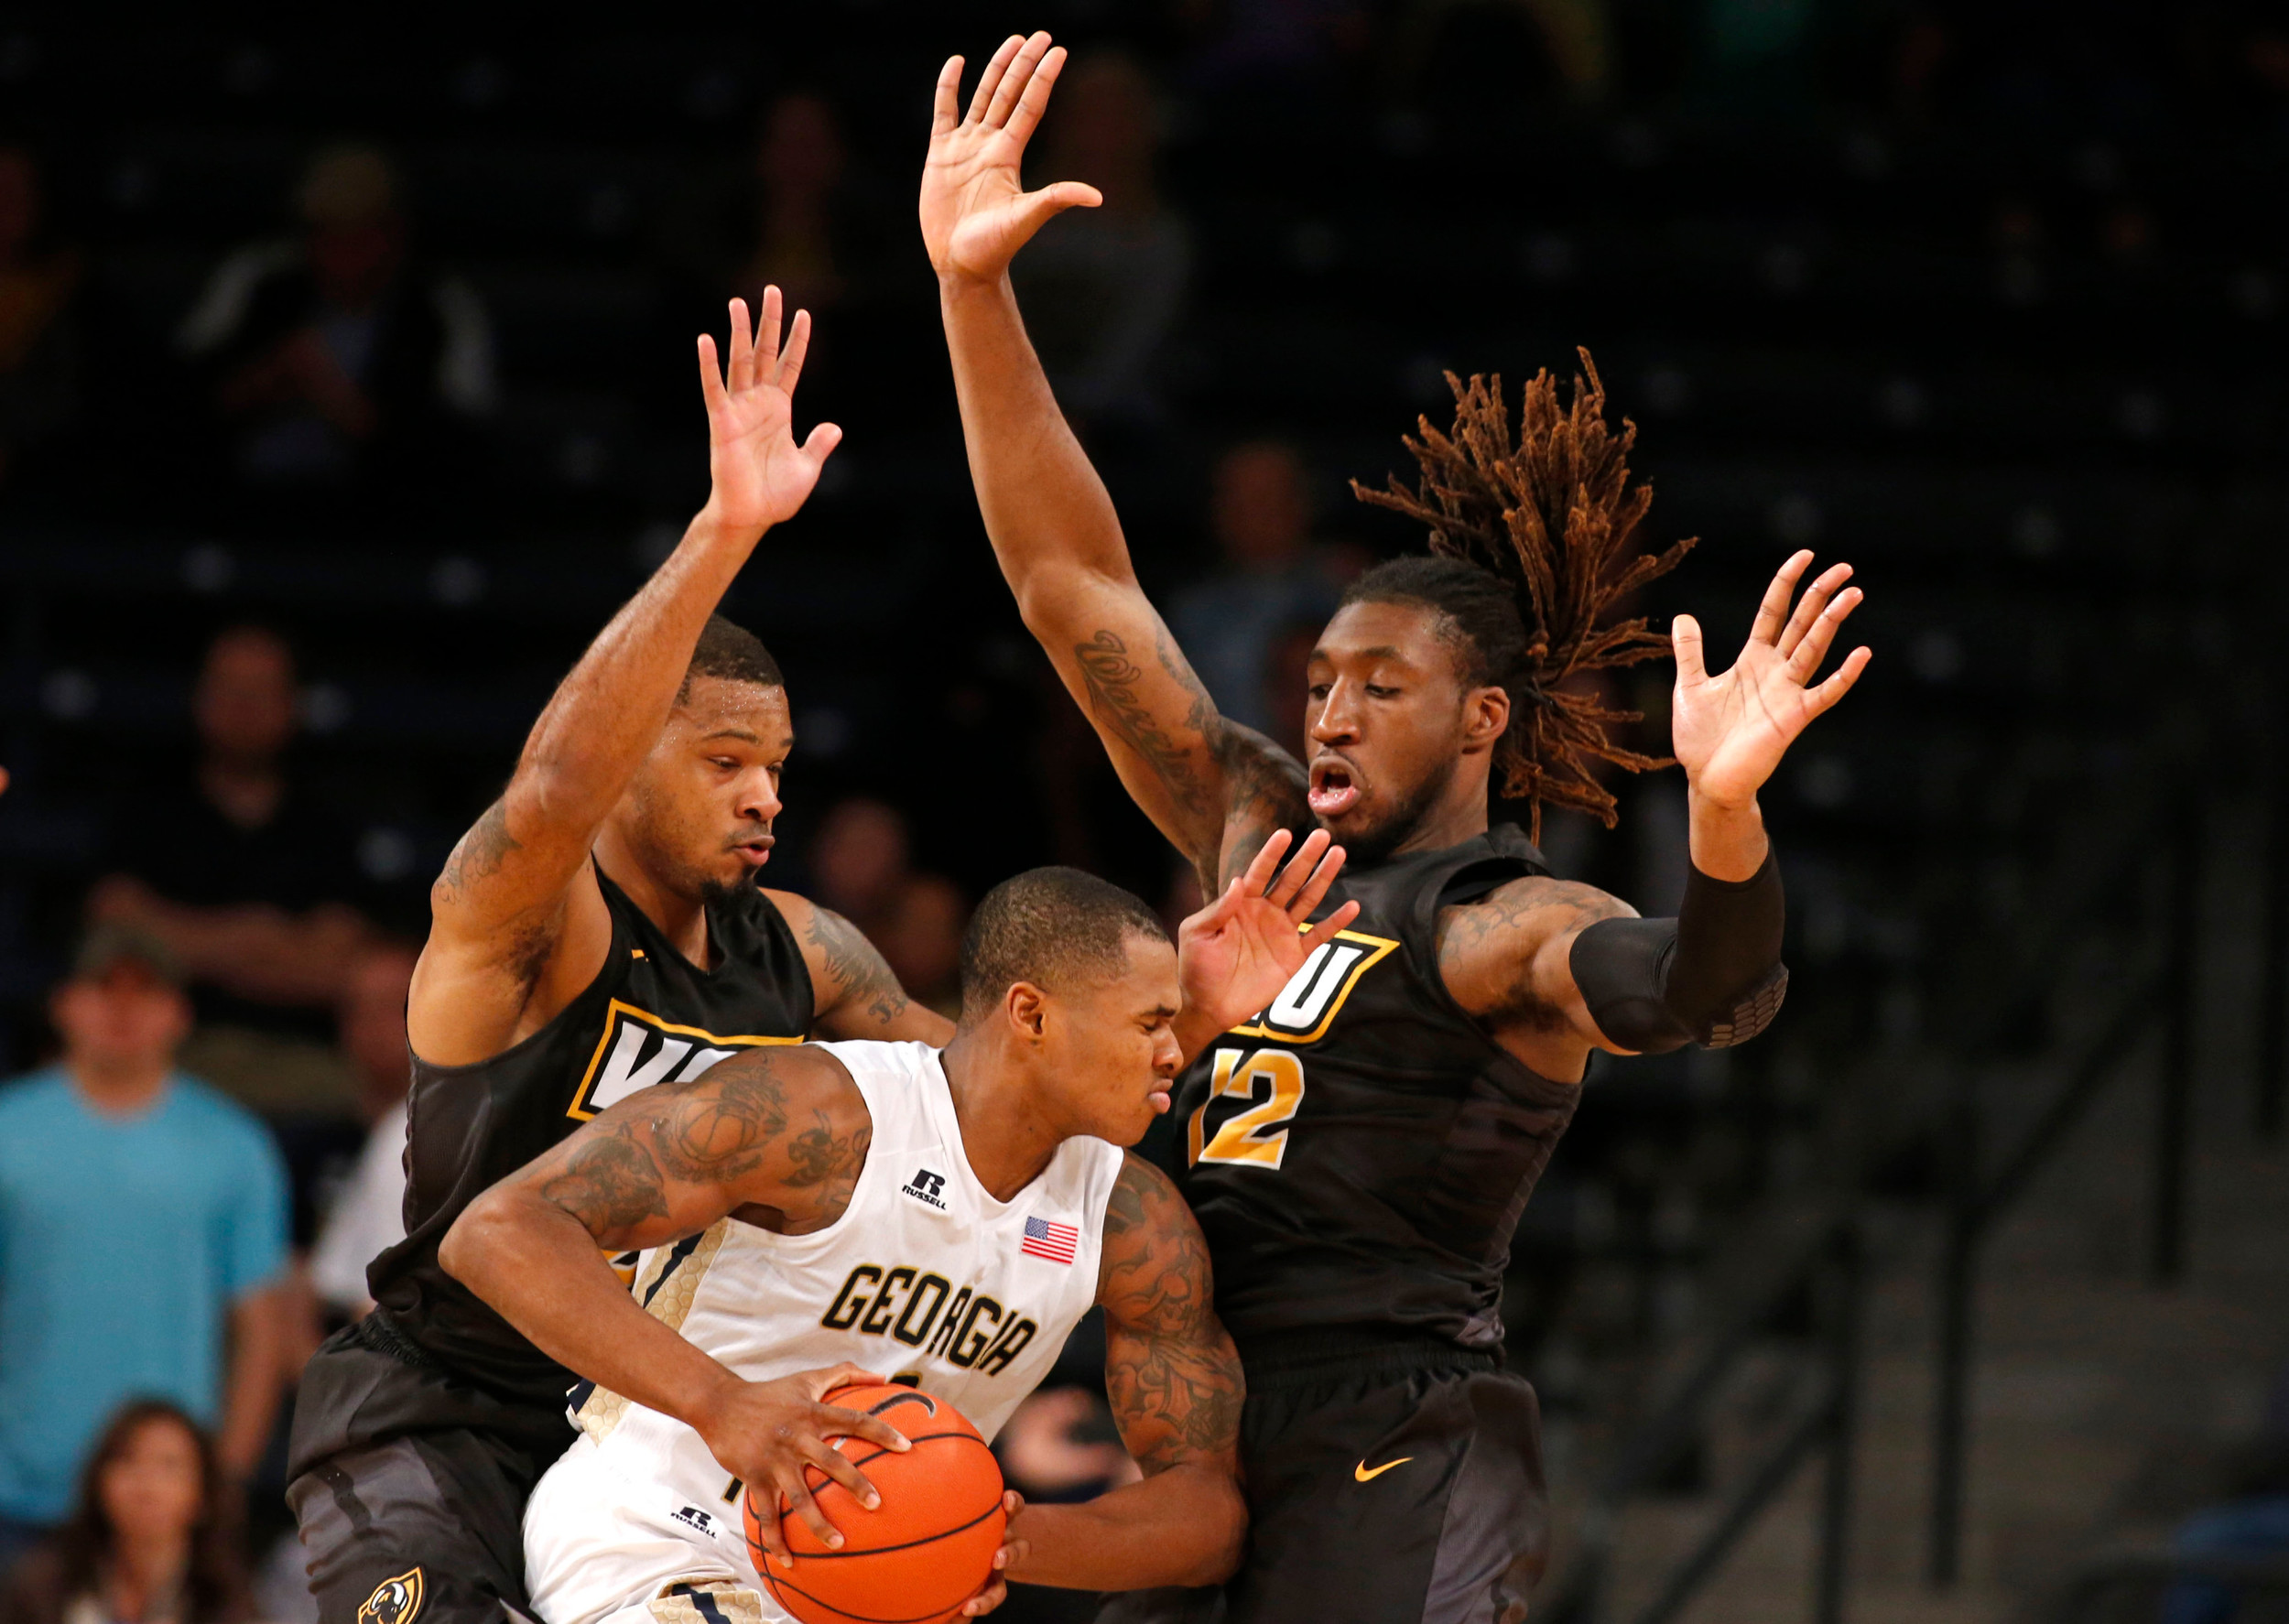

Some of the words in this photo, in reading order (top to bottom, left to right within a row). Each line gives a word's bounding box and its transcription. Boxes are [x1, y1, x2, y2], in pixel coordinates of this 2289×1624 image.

[1252, 942, 1363, 1029] U
[590, 1021, 738, 1109] V
[1188, 1048, 1305, 1171] 12
[902, 1185, 946, 1210] RUSSELL
[820, 1262, 1039, 1378] GEORGIA
[670, 1512, 717, 1539] RUSSELL
